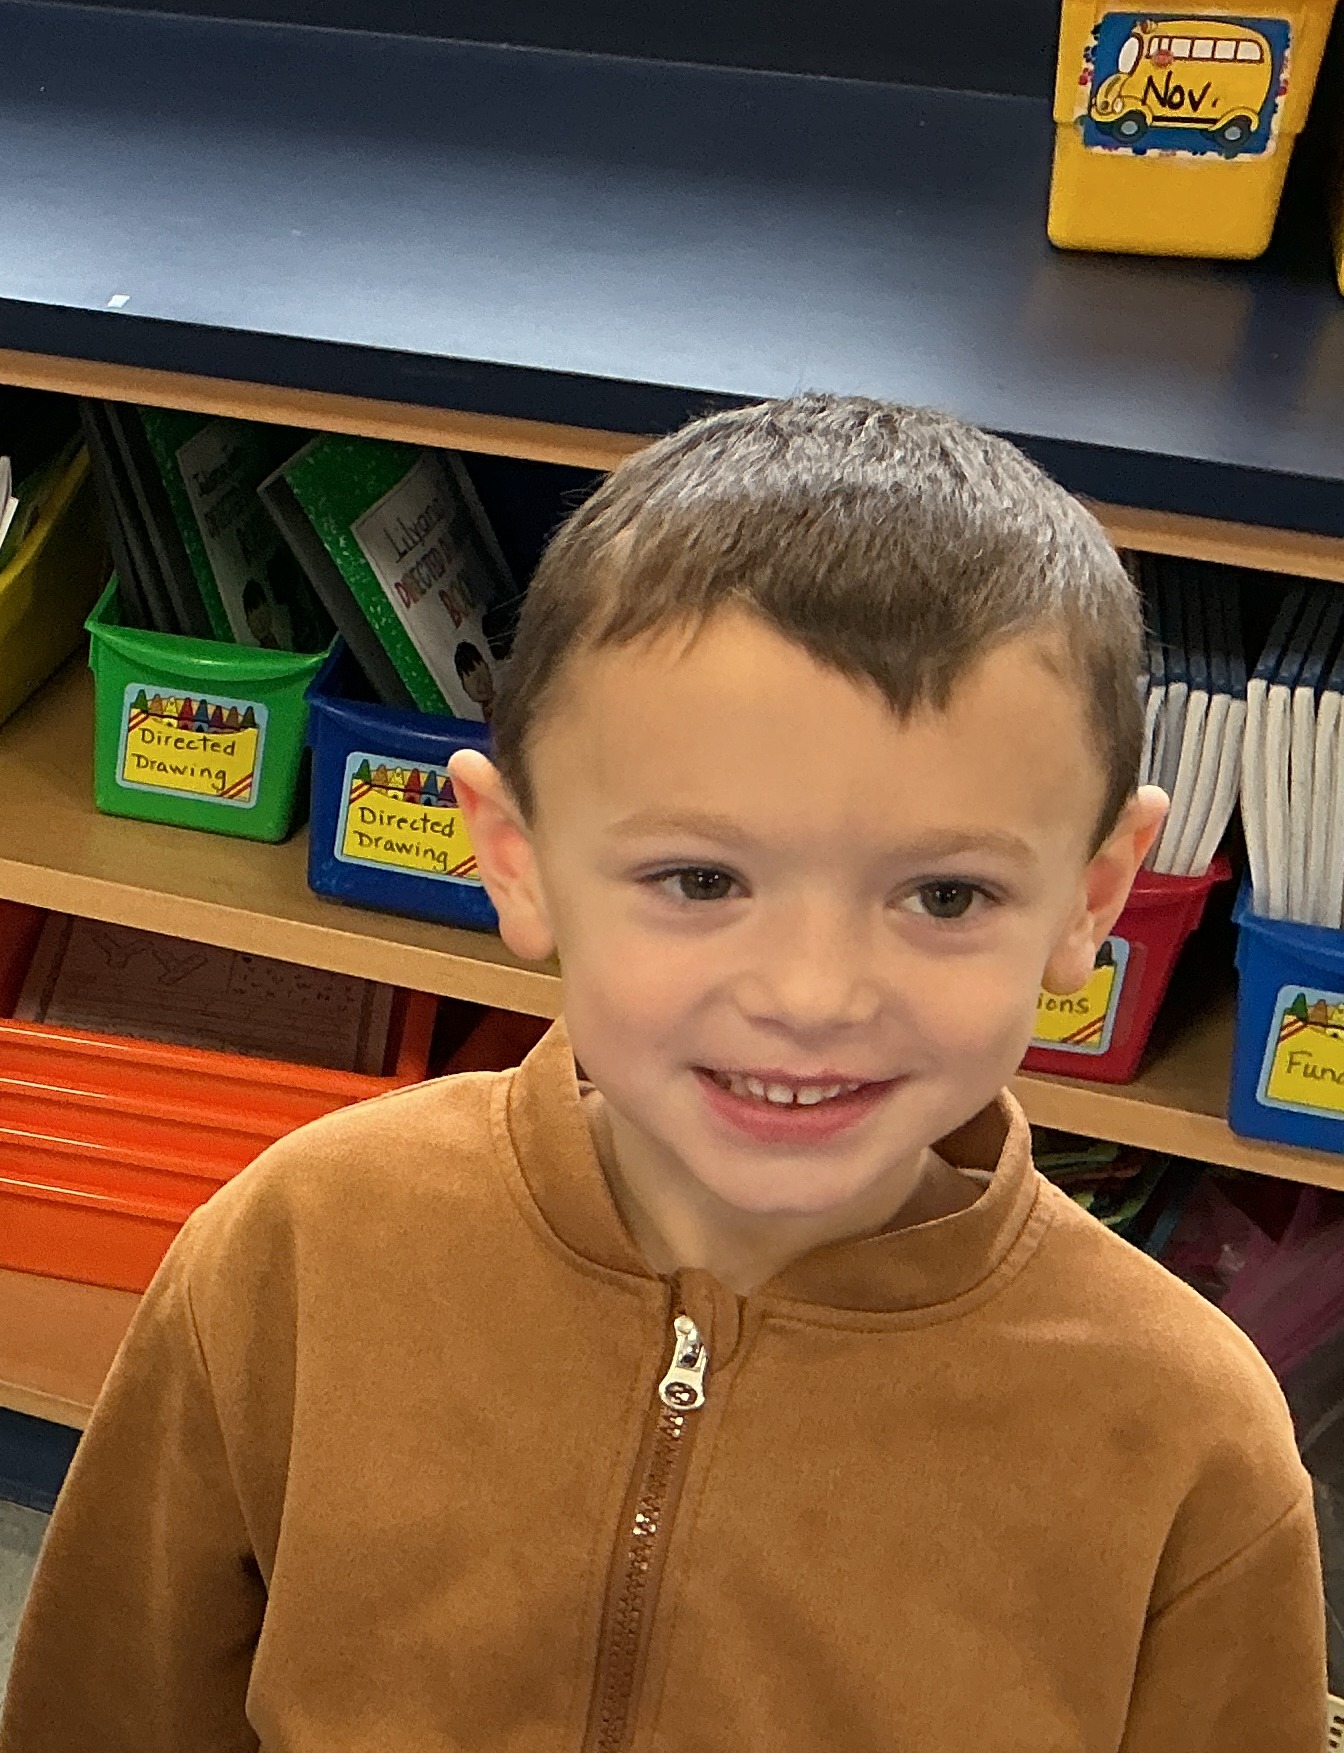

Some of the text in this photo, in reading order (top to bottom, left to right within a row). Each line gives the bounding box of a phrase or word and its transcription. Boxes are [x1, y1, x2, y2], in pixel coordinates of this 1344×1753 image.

[1141, 70, 1220, 111] Nov.
[138, 727, 236, 756] Directed
[131, 752, 227, 792] Drawing
[358, 806, 455, 839] Directed
[352, 830, 449, 872] Drawing
